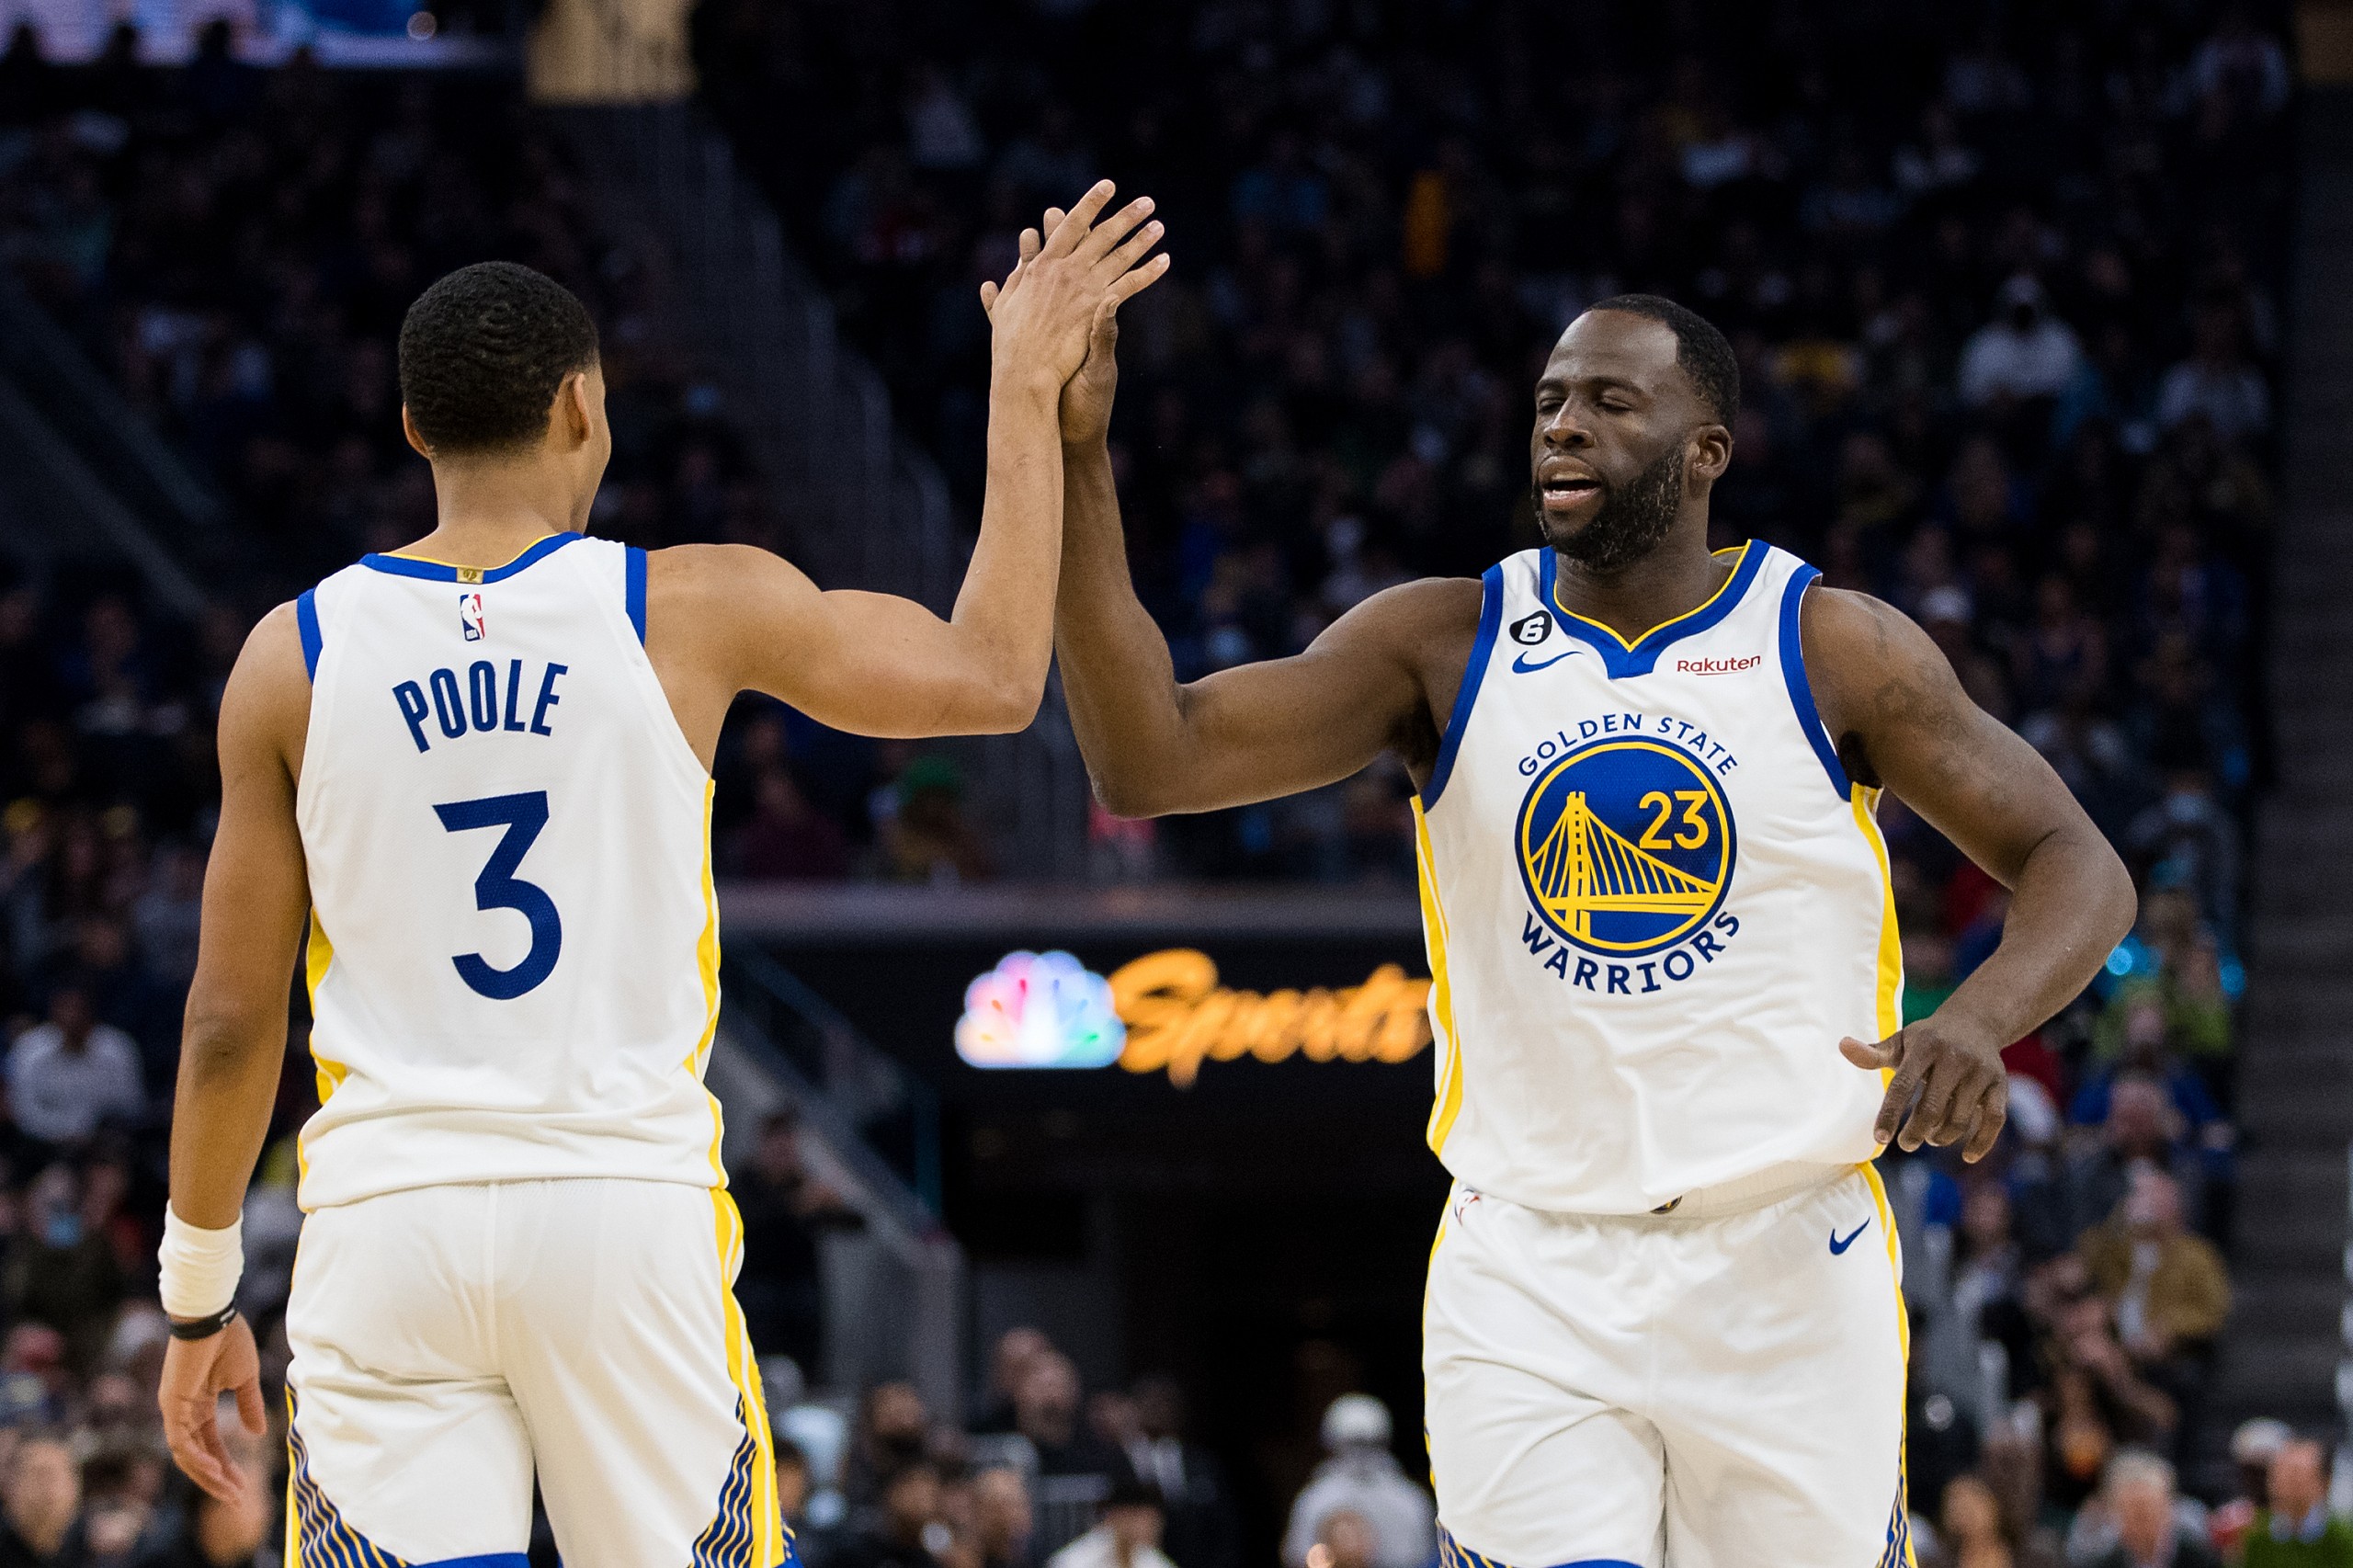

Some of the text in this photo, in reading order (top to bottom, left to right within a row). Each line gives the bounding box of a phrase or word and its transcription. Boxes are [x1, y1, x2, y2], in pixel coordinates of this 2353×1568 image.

[1519, 616, 1544, 642] 6
[1677, 655, 1761, 674] Rakuten
[392, 658, 569, 754] POOLE
[1518, 713, 1738, 777] GOLDEN STATE
[1639, 791, 1710, 850] 23
[432, 790, 562, 1000] 3
[1522, 911, 1739, 994] WARRIORS
[1108, 949, 1433, 1089] Sports
